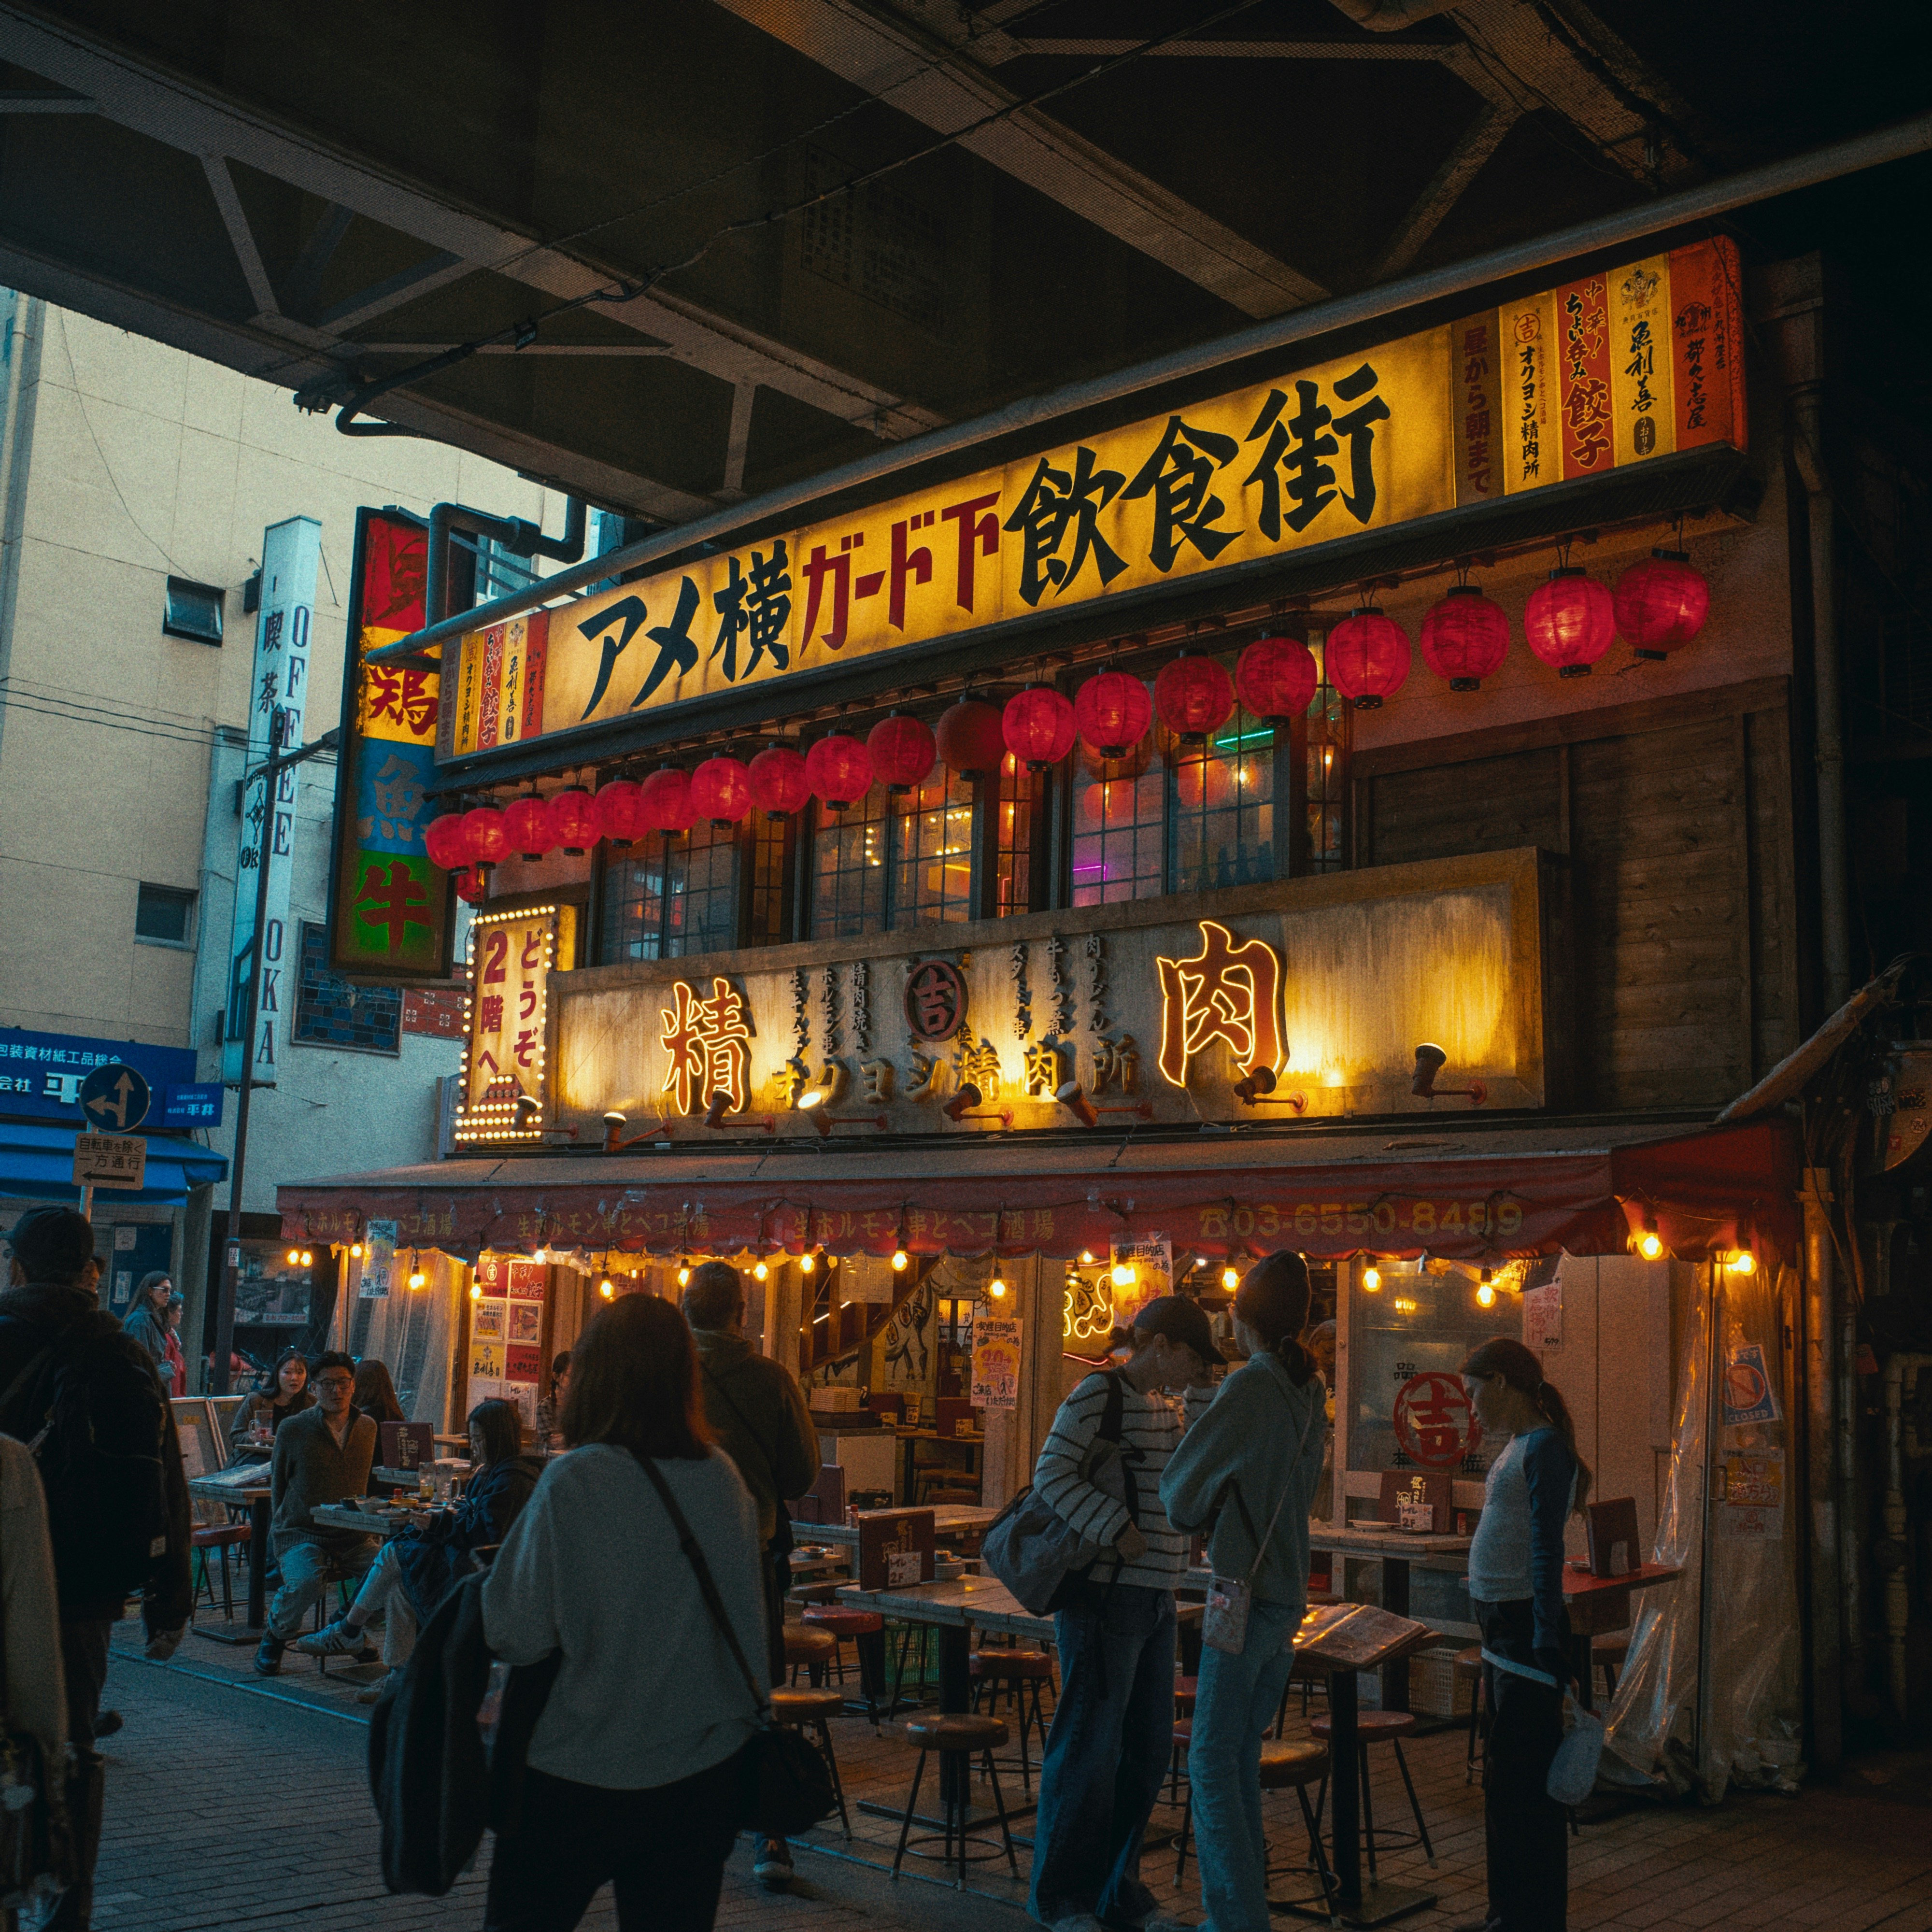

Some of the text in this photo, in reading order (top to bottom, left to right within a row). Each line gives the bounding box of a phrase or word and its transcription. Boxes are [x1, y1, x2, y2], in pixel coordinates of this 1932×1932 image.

[1518, 315, 1537, 341] 吉
[1564, 292, 1591, 381] ちょい呑み
[1463, 325, 1491, 494] 昼から朝まで
[1519, 346, 1540, 481] オクヨシ精肉所
[1563, 378, 1612, 469] 餃子
[461, 663, 473, 748] オクヨシ精肉所
[480, 688, 499, 745] 餃子
[256, 919, 283, 1065] OKA
[477, 930, 508, 1075] 2階へ
[513, 927, 543, 1067] どうぞ
[660, 920, 1279, 1115] 精 肉
[851, 962, 870, 1053] 精肉焼き
[909, 966, 955, 1037] 吉
[1047, 937, 1066, 1036] 牛もつ煮
[1087, 933, 1104, 1032] 肉うどん
[187, 1103, 215, 1116] 平井
[772, 1034, 1136, 1109] オクヨシ精肉所
[79, 1137, 143, 1154] 自転車を除く
[79, 1154, 141, 1170] 一方通行
[976, 1321, 1017, 1333] 喫煙目的店
[1394, 1363, 1419, 1381] 品
[1729, 1409, 1768, 1422] CLOSED
